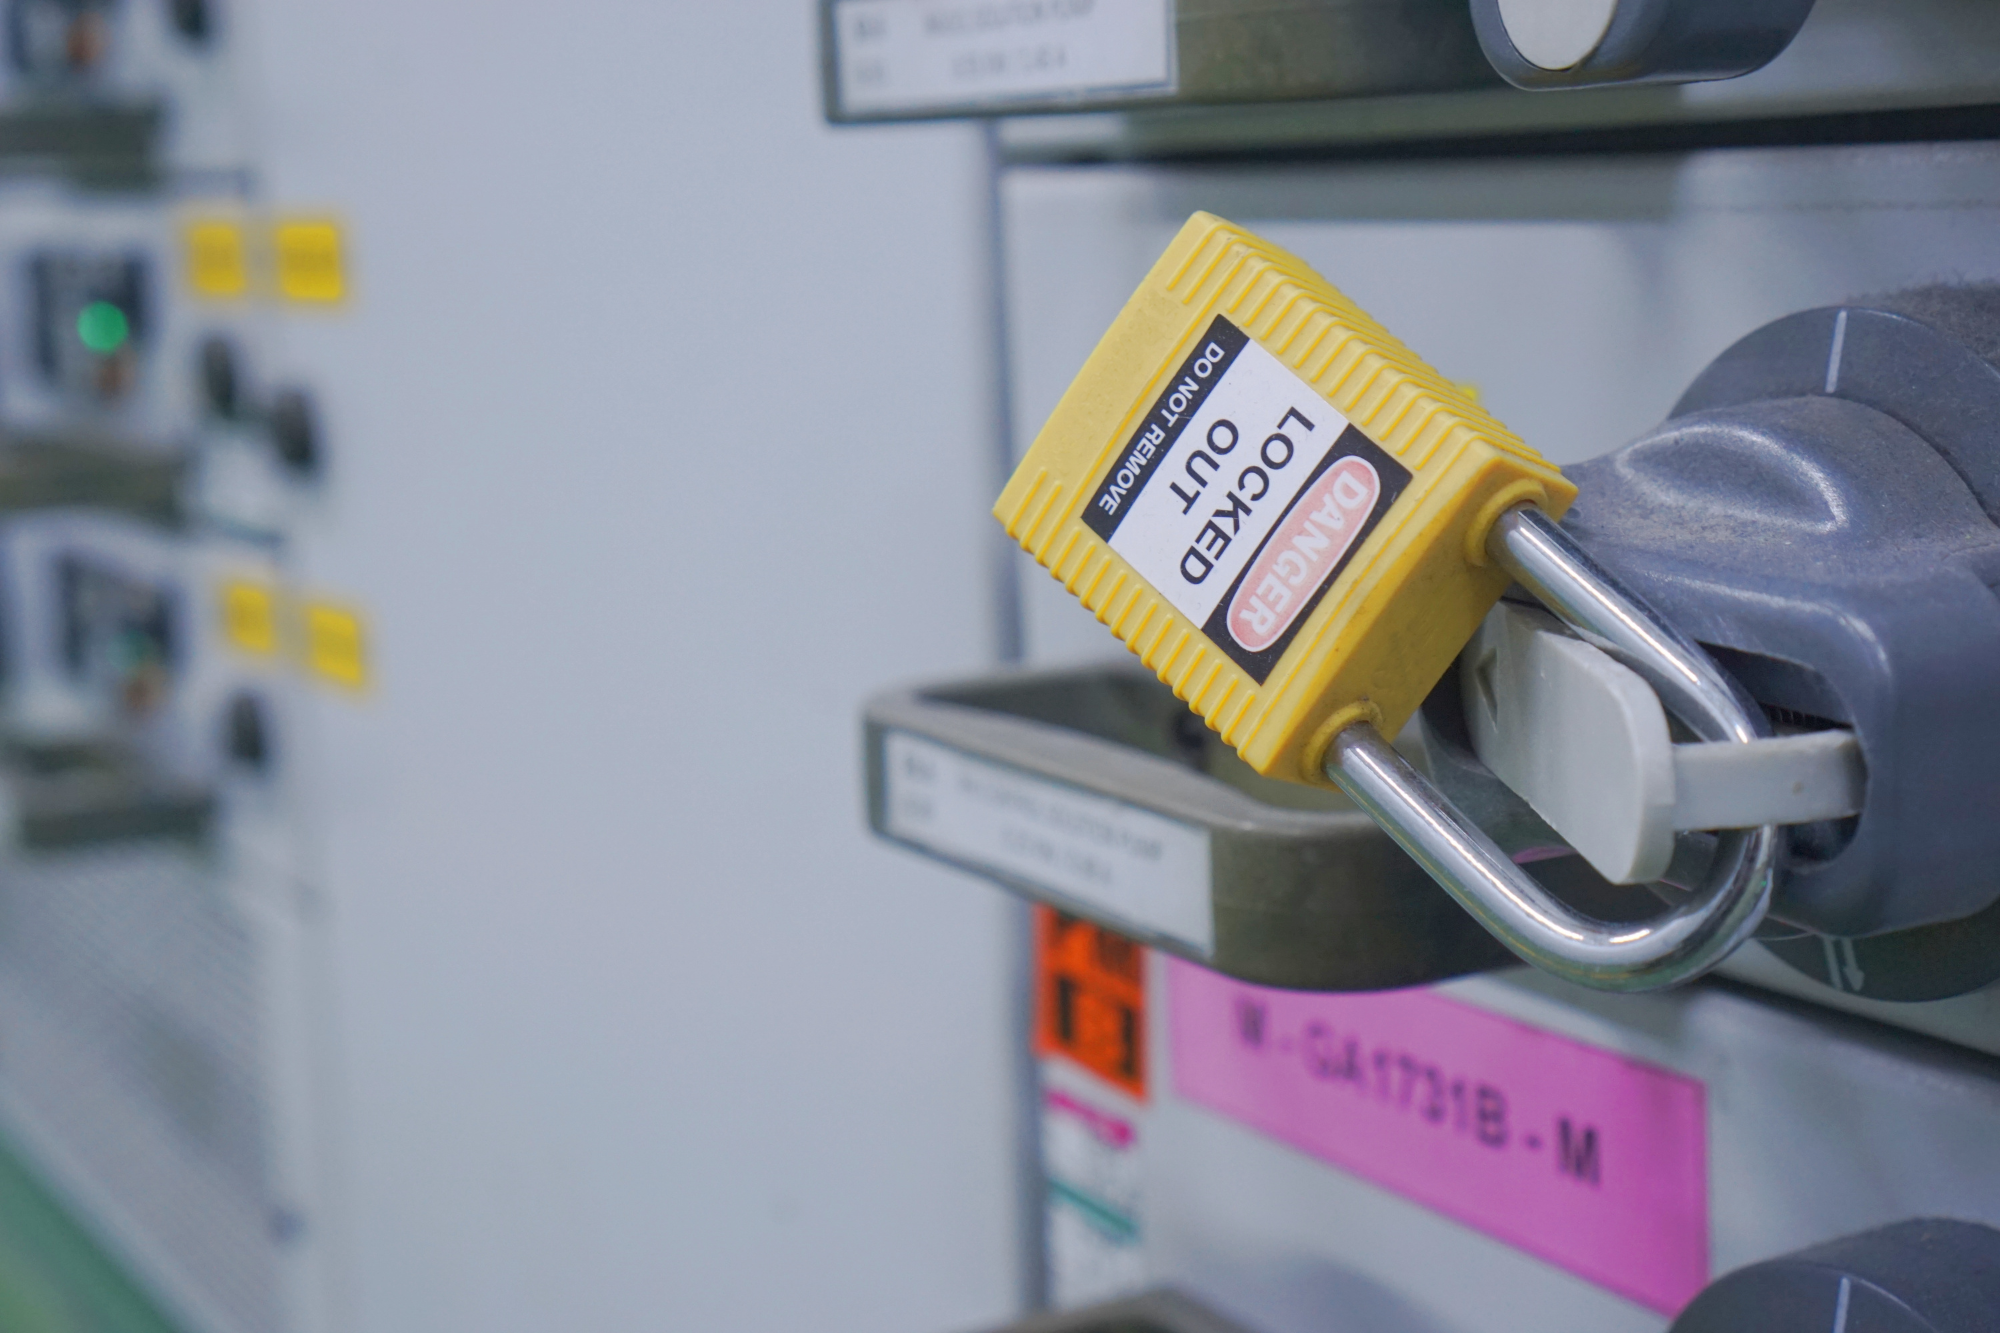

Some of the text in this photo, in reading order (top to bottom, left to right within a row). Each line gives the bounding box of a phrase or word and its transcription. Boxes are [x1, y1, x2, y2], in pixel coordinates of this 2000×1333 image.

[1099, 342, 1225, 515] DO NOT REMOVE
[1169, 419, 1239, 515] OUT
[1180, 406, 1315, 584] LOCKED
[1239, 470, 1368, 635] DANGER
